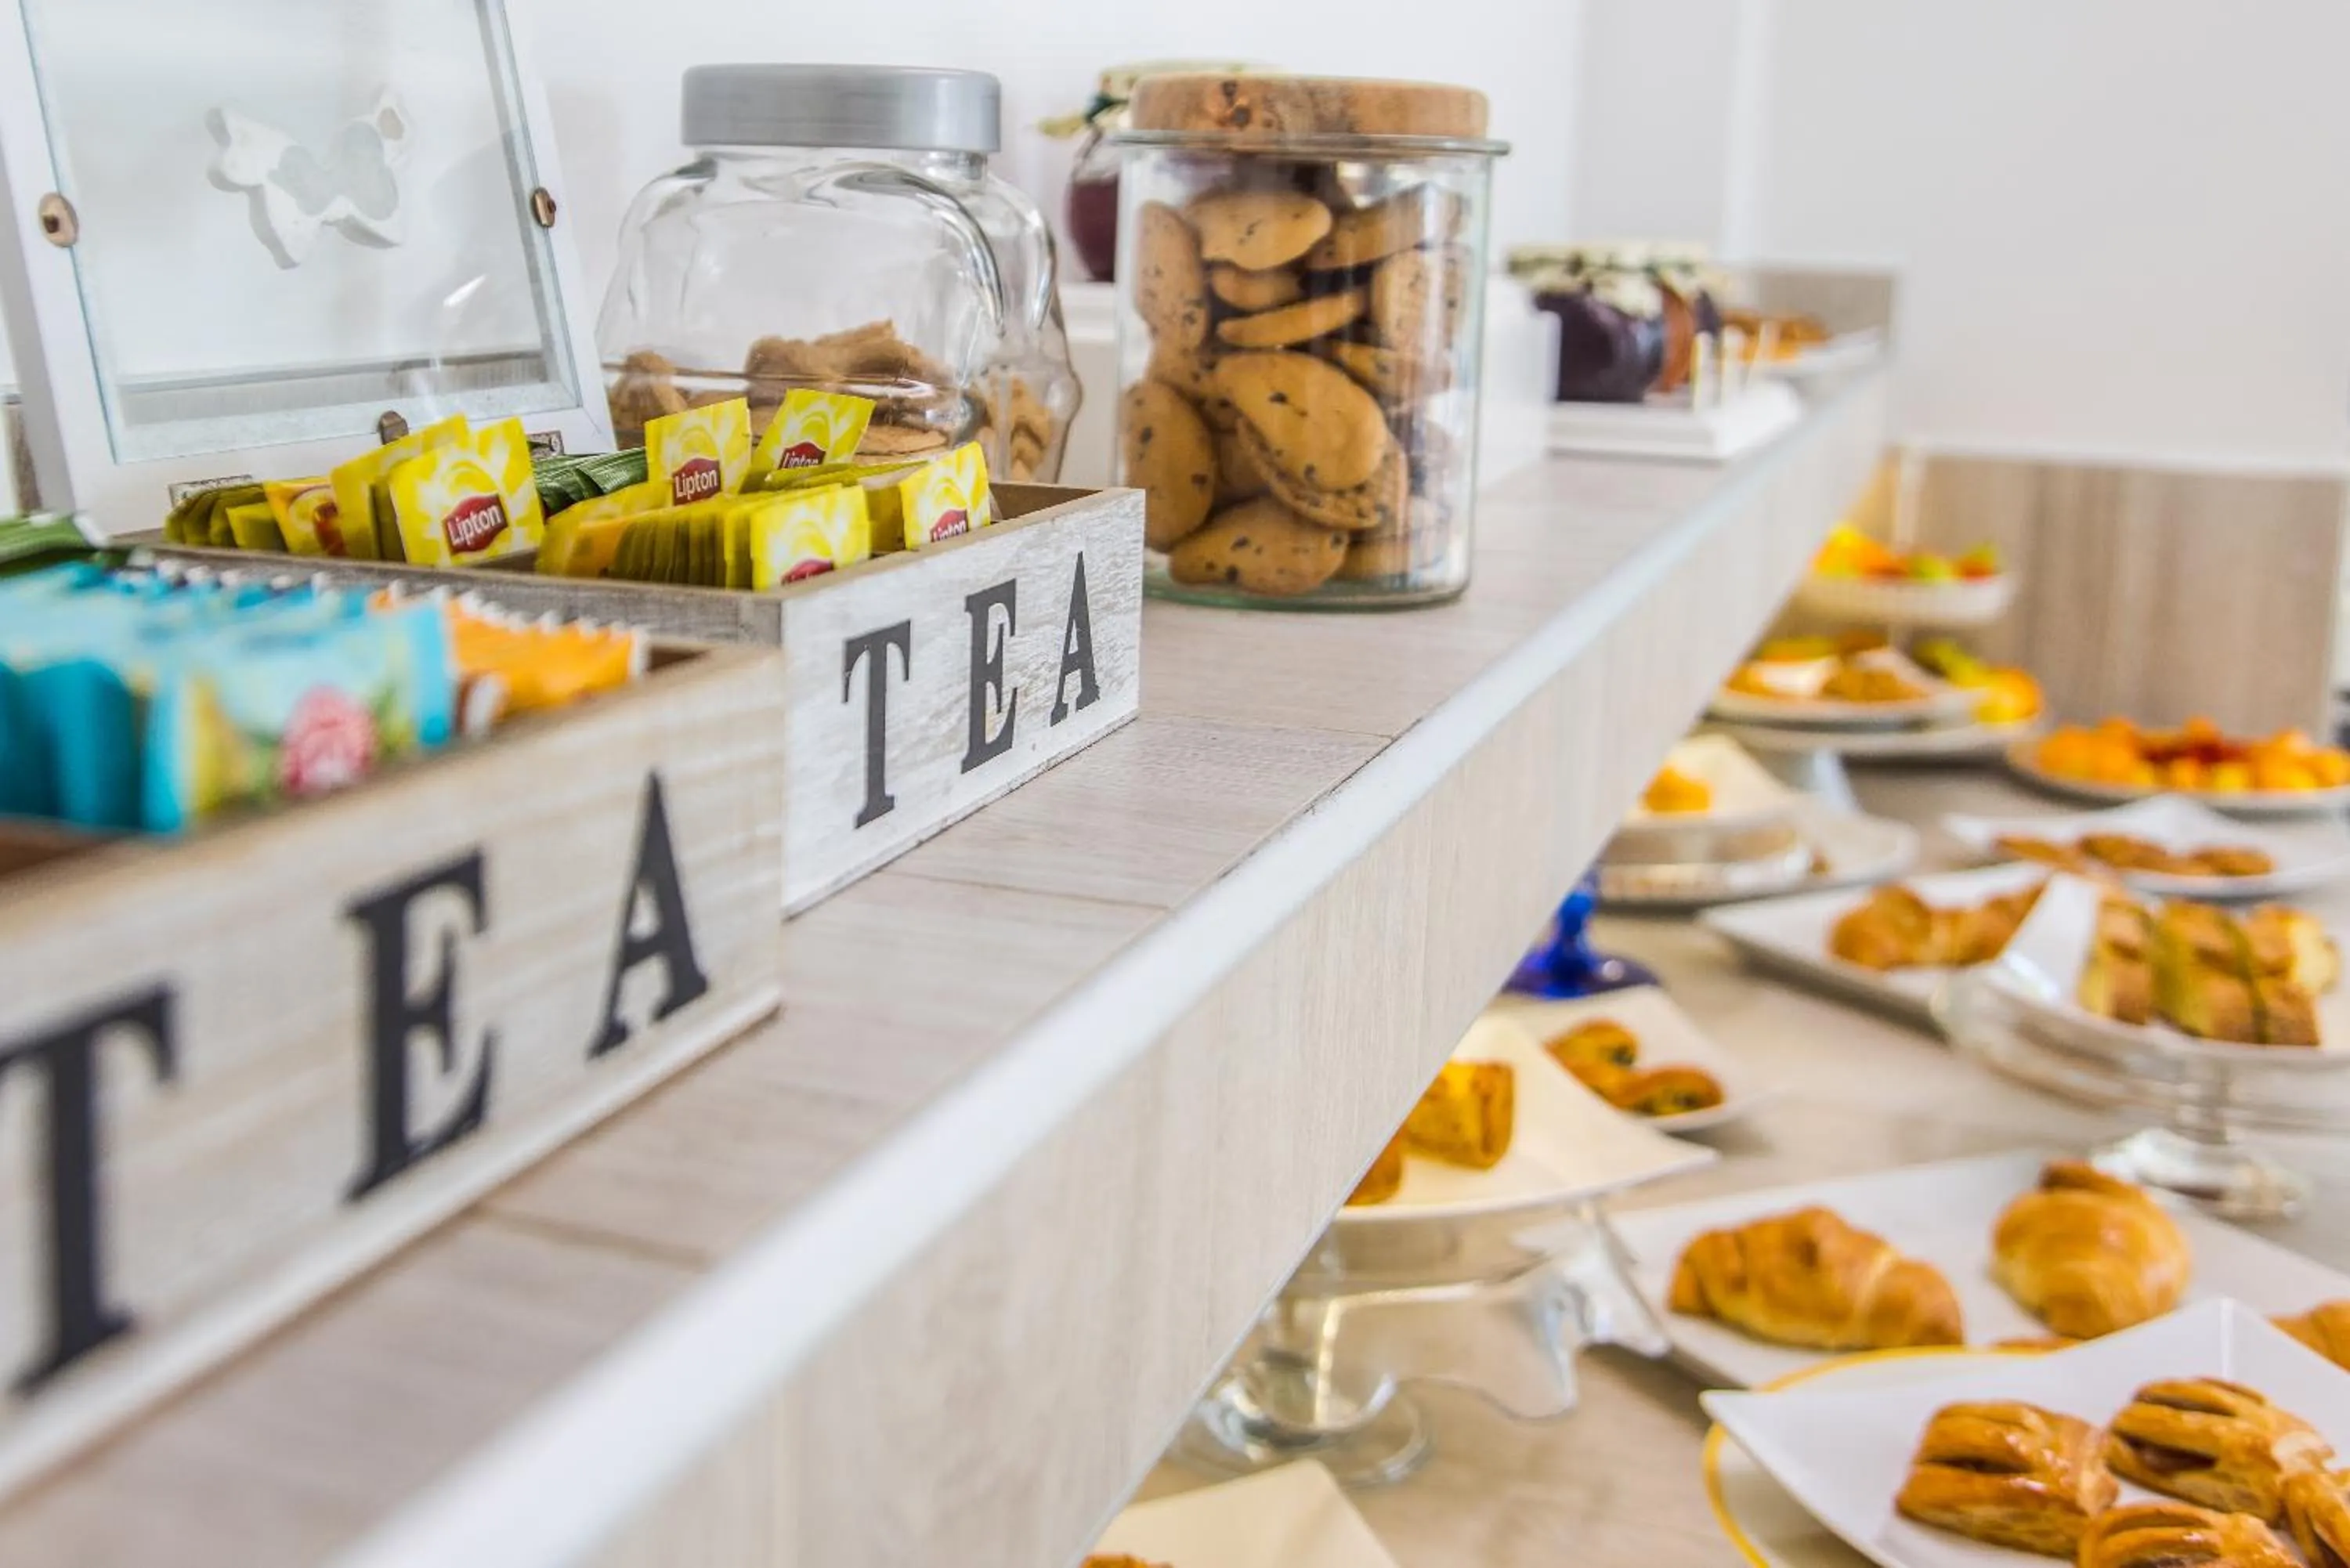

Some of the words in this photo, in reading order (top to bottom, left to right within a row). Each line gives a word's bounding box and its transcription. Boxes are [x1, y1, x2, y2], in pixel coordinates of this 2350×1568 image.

[446, 504, 502, 547] Lipton
[675, 468, 718, 500] Lipton
[841, 551, 1100, 829] TEA
[0, 770, 708, 1397] TEA
